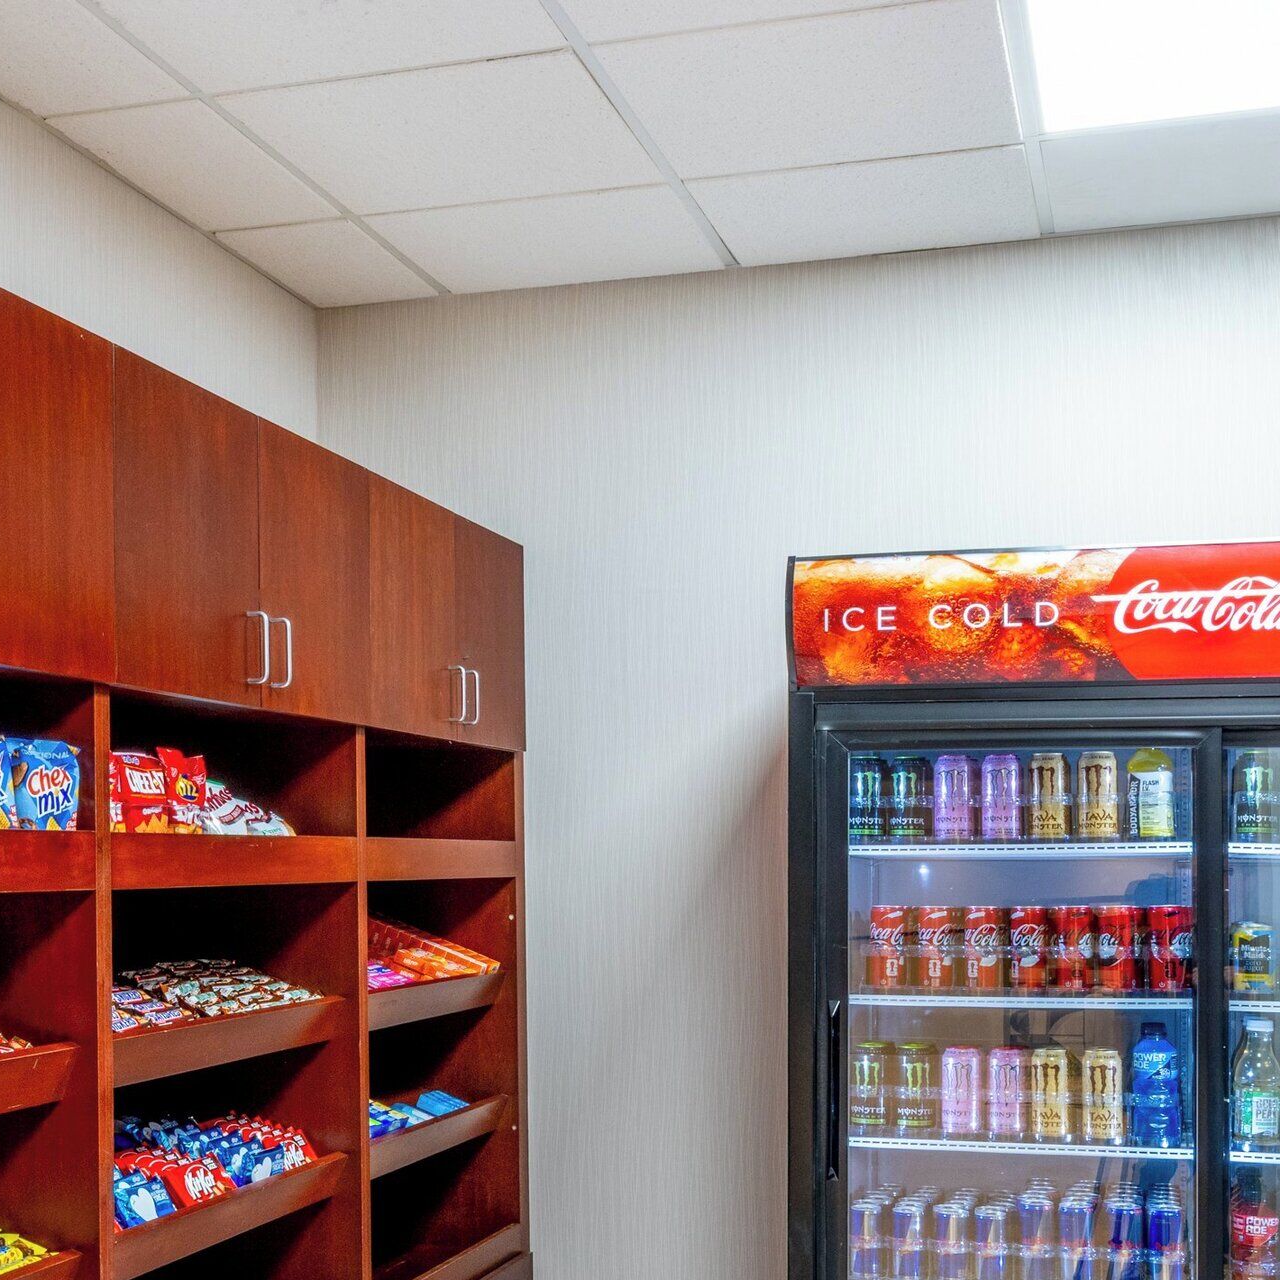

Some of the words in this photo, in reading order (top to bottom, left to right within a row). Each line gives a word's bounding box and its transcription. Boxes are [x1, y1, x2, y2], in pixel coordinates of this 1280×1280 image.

[825, 604, 896, 631] ICE
[927, 599, 1060, 629] COLD
[27, 766, 71, 795] Chex
[39, 787, 71, 815] mix
[1246, 1217, 1279, 1226] POWER
[1246, 1225, 1267, 1234] ADE
